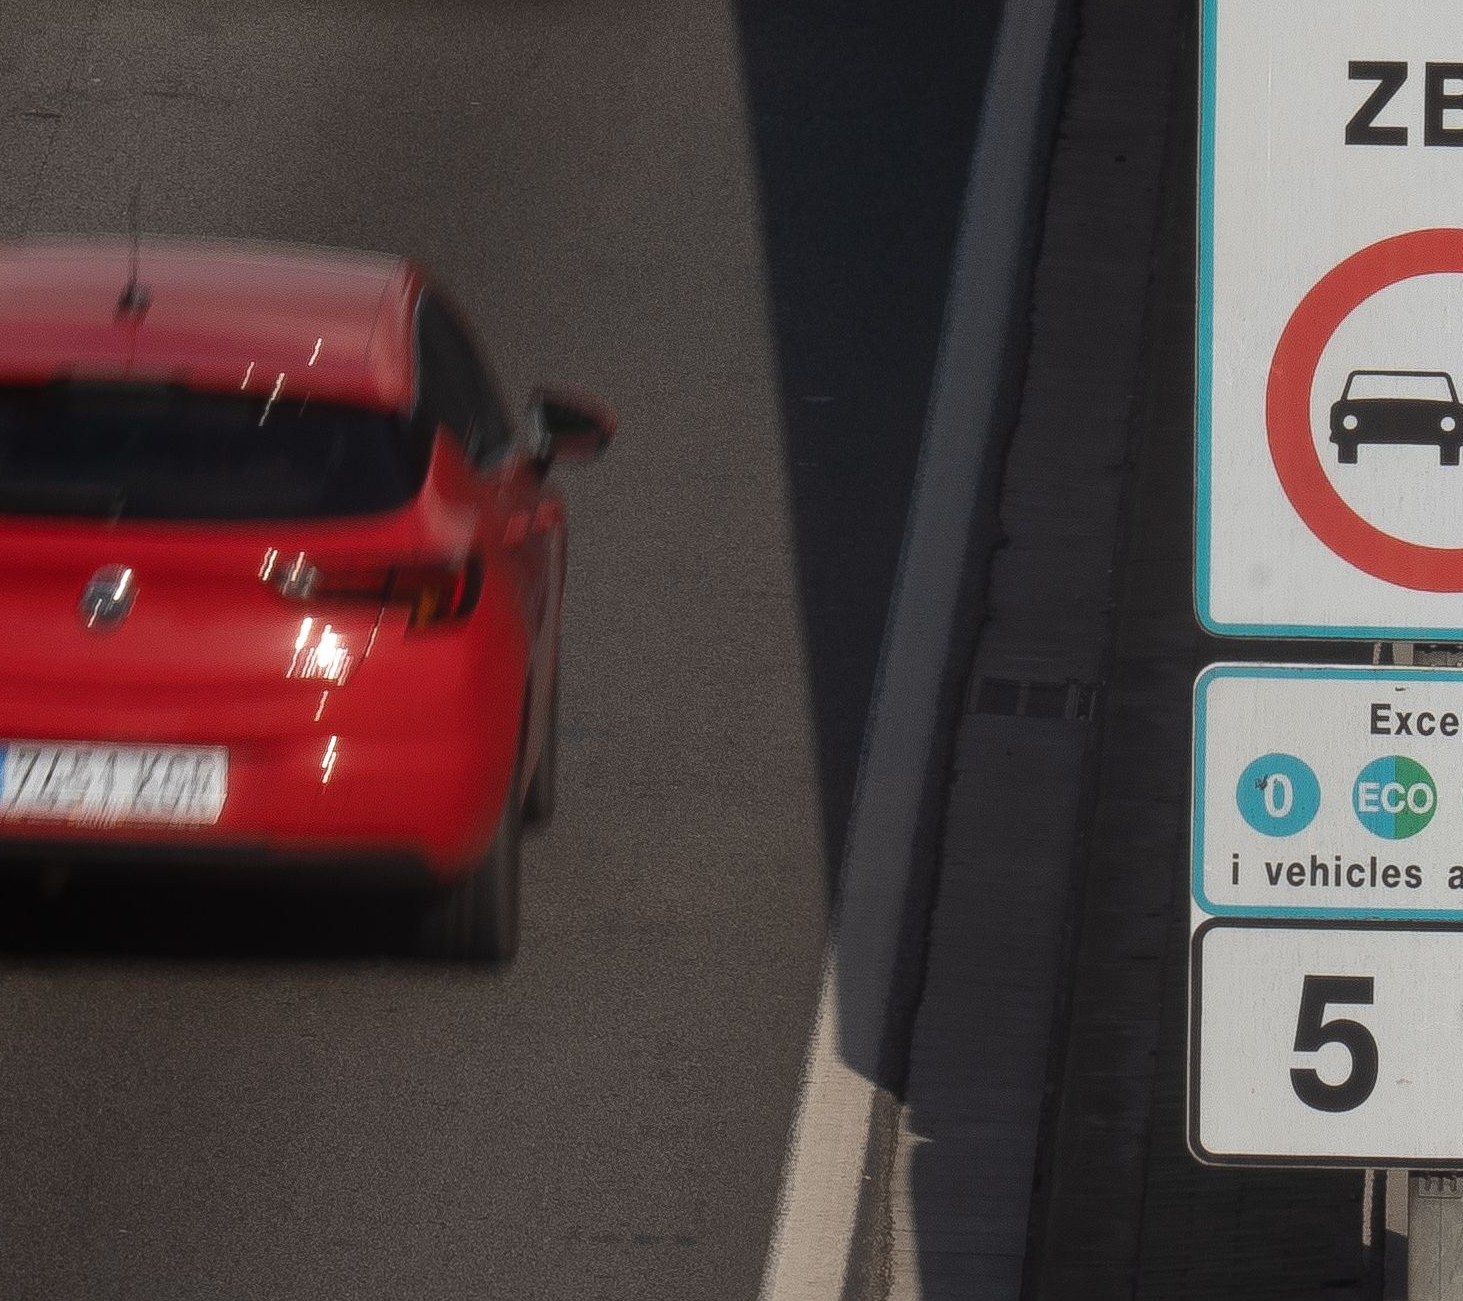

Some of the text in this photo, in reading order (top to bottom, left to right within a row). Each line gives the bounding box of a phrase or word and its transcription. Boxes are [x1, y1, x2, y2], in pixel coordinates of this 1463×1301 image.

[1357, 781, 1434, 815] ECO
[1231, 853, 1240, 886] i
[1264, 854, 1423, 889] vehicles
[1289, 974, 1379, 1114] 5
